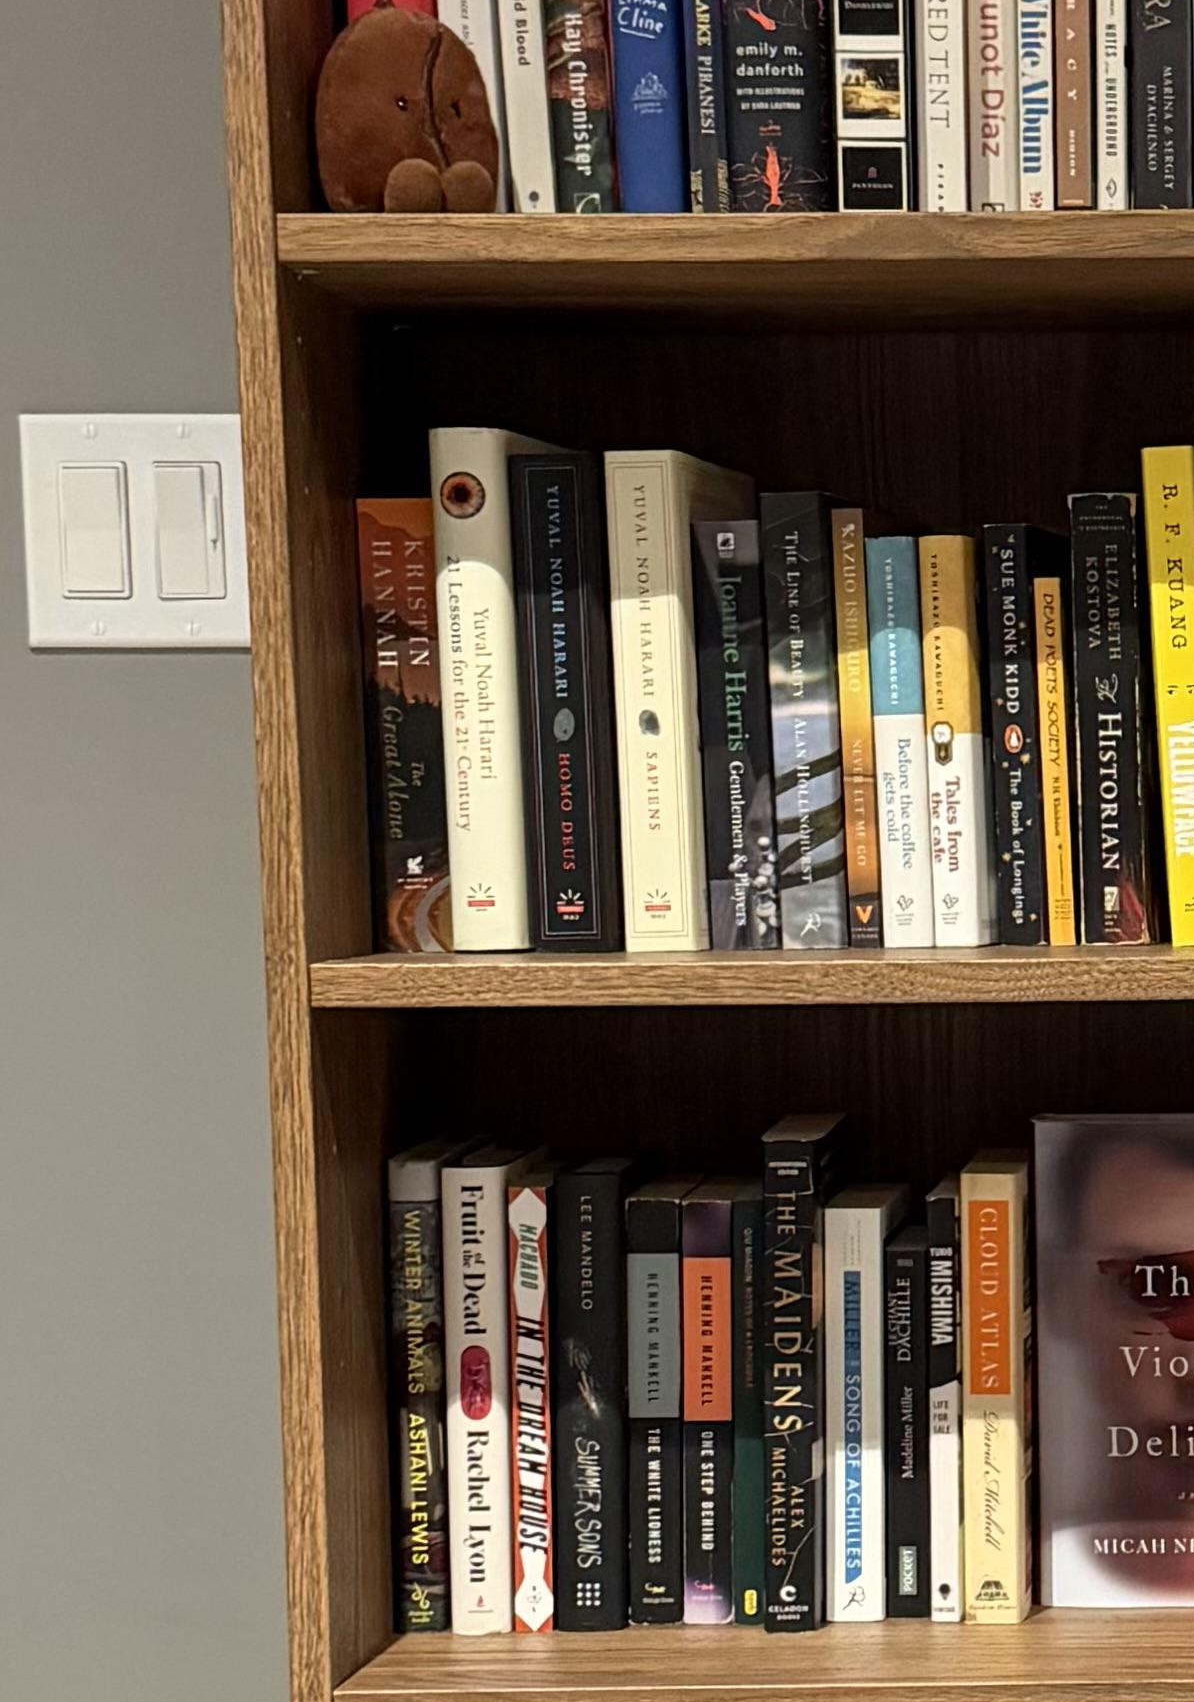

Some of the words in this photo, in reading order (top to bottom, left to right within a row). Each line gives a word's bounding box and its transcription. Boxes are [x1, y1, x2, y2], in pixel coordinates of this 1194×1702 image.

[513, 19, 529, 66] Blood
[736, 43, 778, 59] emily
[784, 45, 803, 57] m.
[736, 63, 804, 78] danforth
[1000, 549, 1013, 590] SUE
[372, 541, 398, 668] HANNAH
[404, 541, 430, 667] KRISTIN
[1002, 597, 1016, 656] MONK
[1005, 665, 1019, 714] KIDD
[646, 752, 660, 832] SAPIENS
[1098, 711, 1120, 870] HISTORIAN
[979, 1208, 997, 1295] CLOUD
[931, 1260, 953, 1346] MISHIMA
[979, 1309, 998, 1389] ATLAS
[408, 1414, 428, 1494] ASHANI
[648, 1428, 660, 1455] THE
[467, 1430, 491, 1517] Rachel
[648, 1460, 660, 1502] WHITE
[411, 1500, 428, 1565] LEWIS
[464, 1526, 492, 1583] Lyon
[648, 1507, 661, 1564] LIONESS
[1094, 1538, 1166, 1555] MICAH
